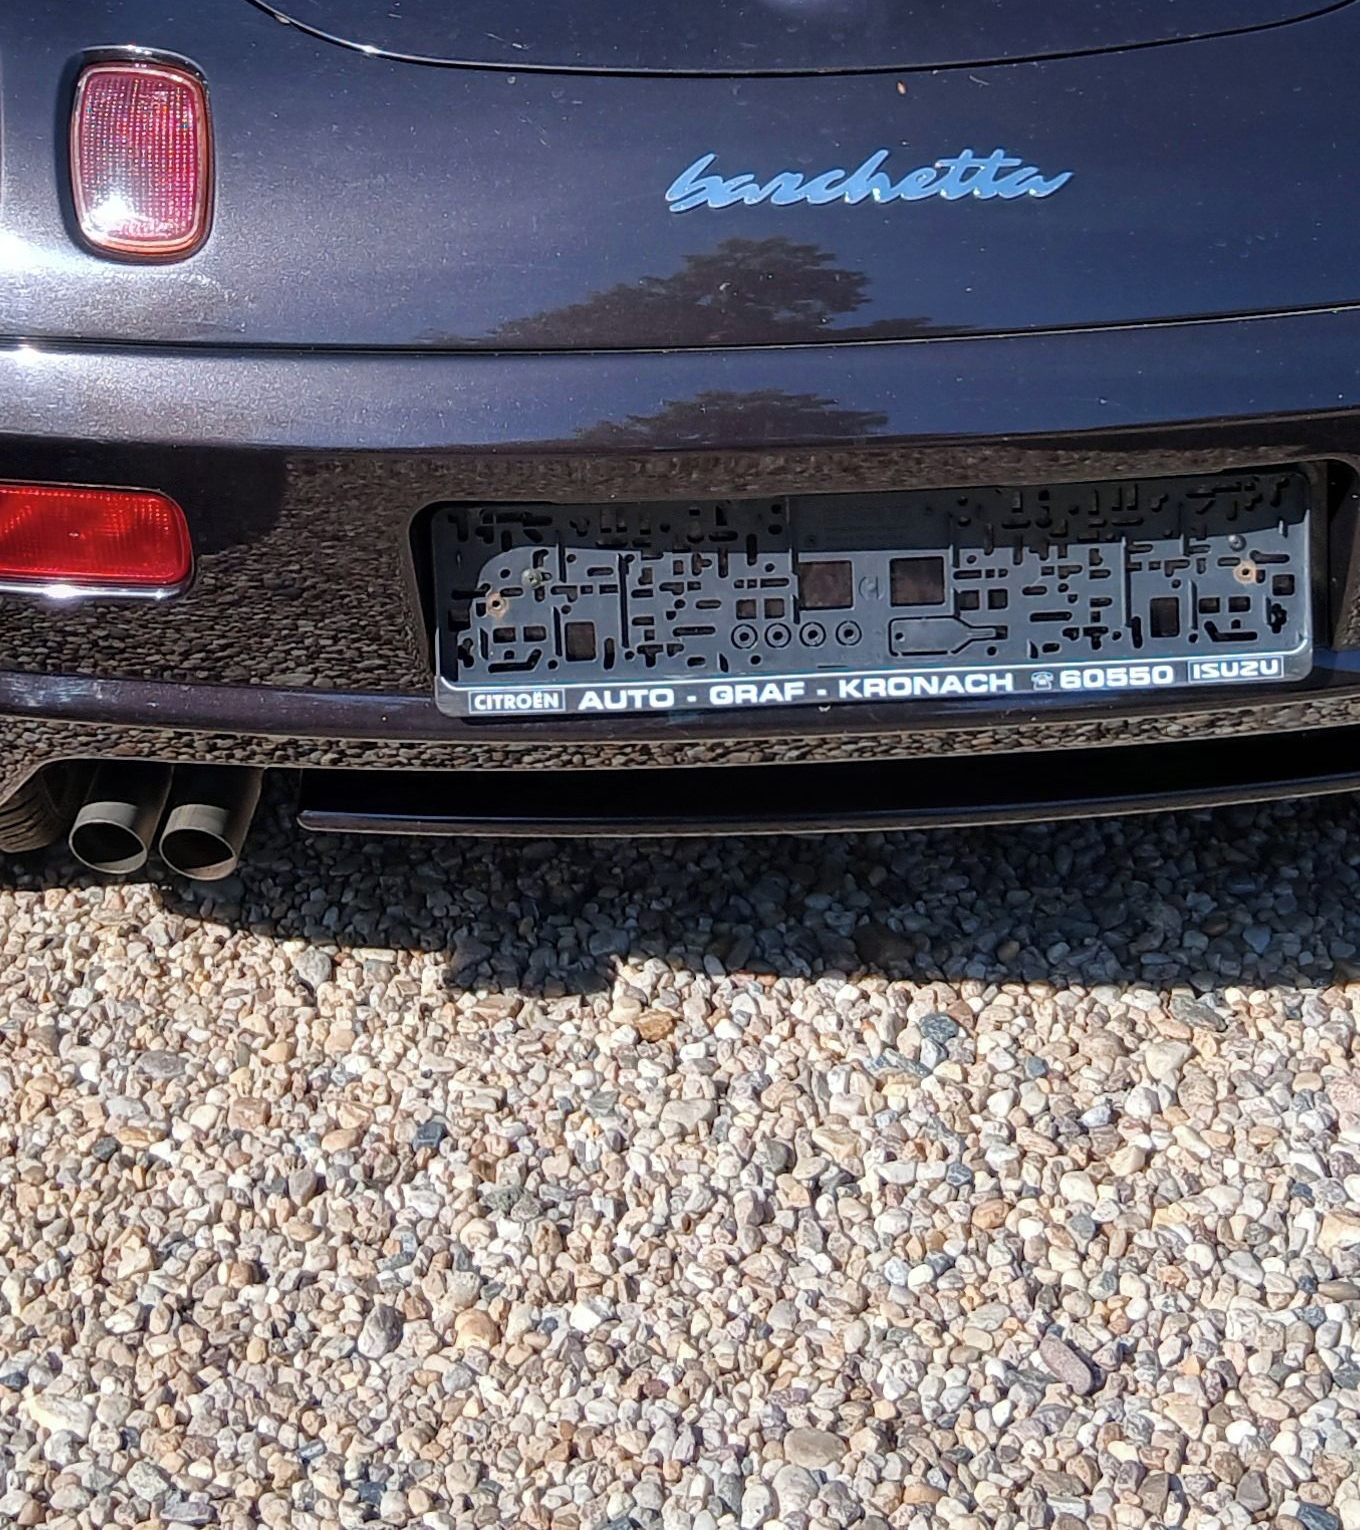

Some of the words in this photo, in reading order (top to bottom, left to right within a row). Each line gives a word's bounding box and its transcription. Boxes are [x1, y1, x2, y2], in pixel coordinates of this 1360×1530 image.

[665, 149, 1075, 214] barchetta
[473, 691, 560, 711] CITROËN
[578, 688, 675, 711] AUTO
[709, 681, 805, 705] GRAF
[838, 673, 1013, 699] KRONACH
[1058, 665, 1175, 690] 60550
[1192, 659, 1279, 680] ISUZU
